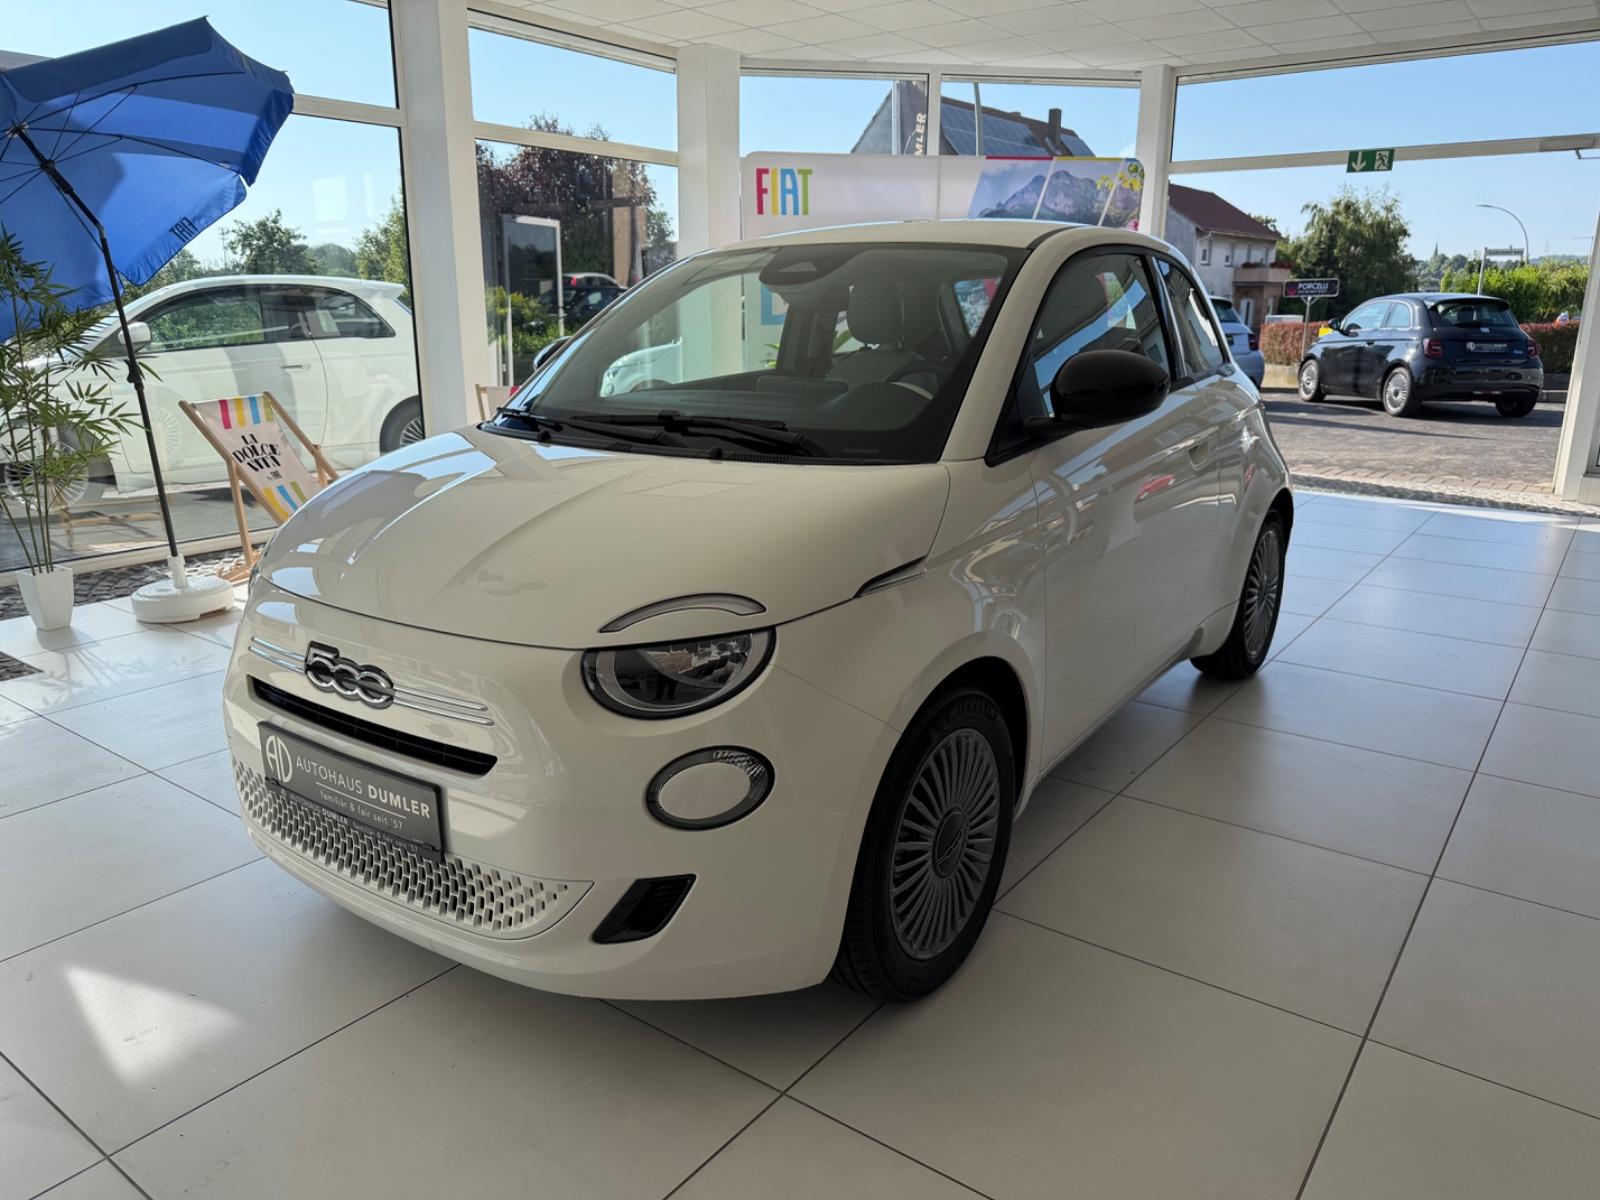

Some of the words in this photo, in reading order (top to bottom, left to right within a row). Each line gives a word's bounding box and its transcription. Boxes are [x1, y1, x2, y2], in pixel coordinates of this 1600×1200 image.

[756, 168, 813, 216] FIAT
[232, 443, 281, 464] DOLCE
[247, 456, 281, 472] VITA
[305, 643, 393, 708] 500
[266, 735, 293, 783] AD
[296, 756, 363, 794] AUTOHAUS
[368, 785, 431, 818] DUMLER
[322, 808, 348, 825] DUMLER
[350, 802, 355, 812] &
[358, 804, 370, 816] fair
[373, 814, 388, 825] seit
